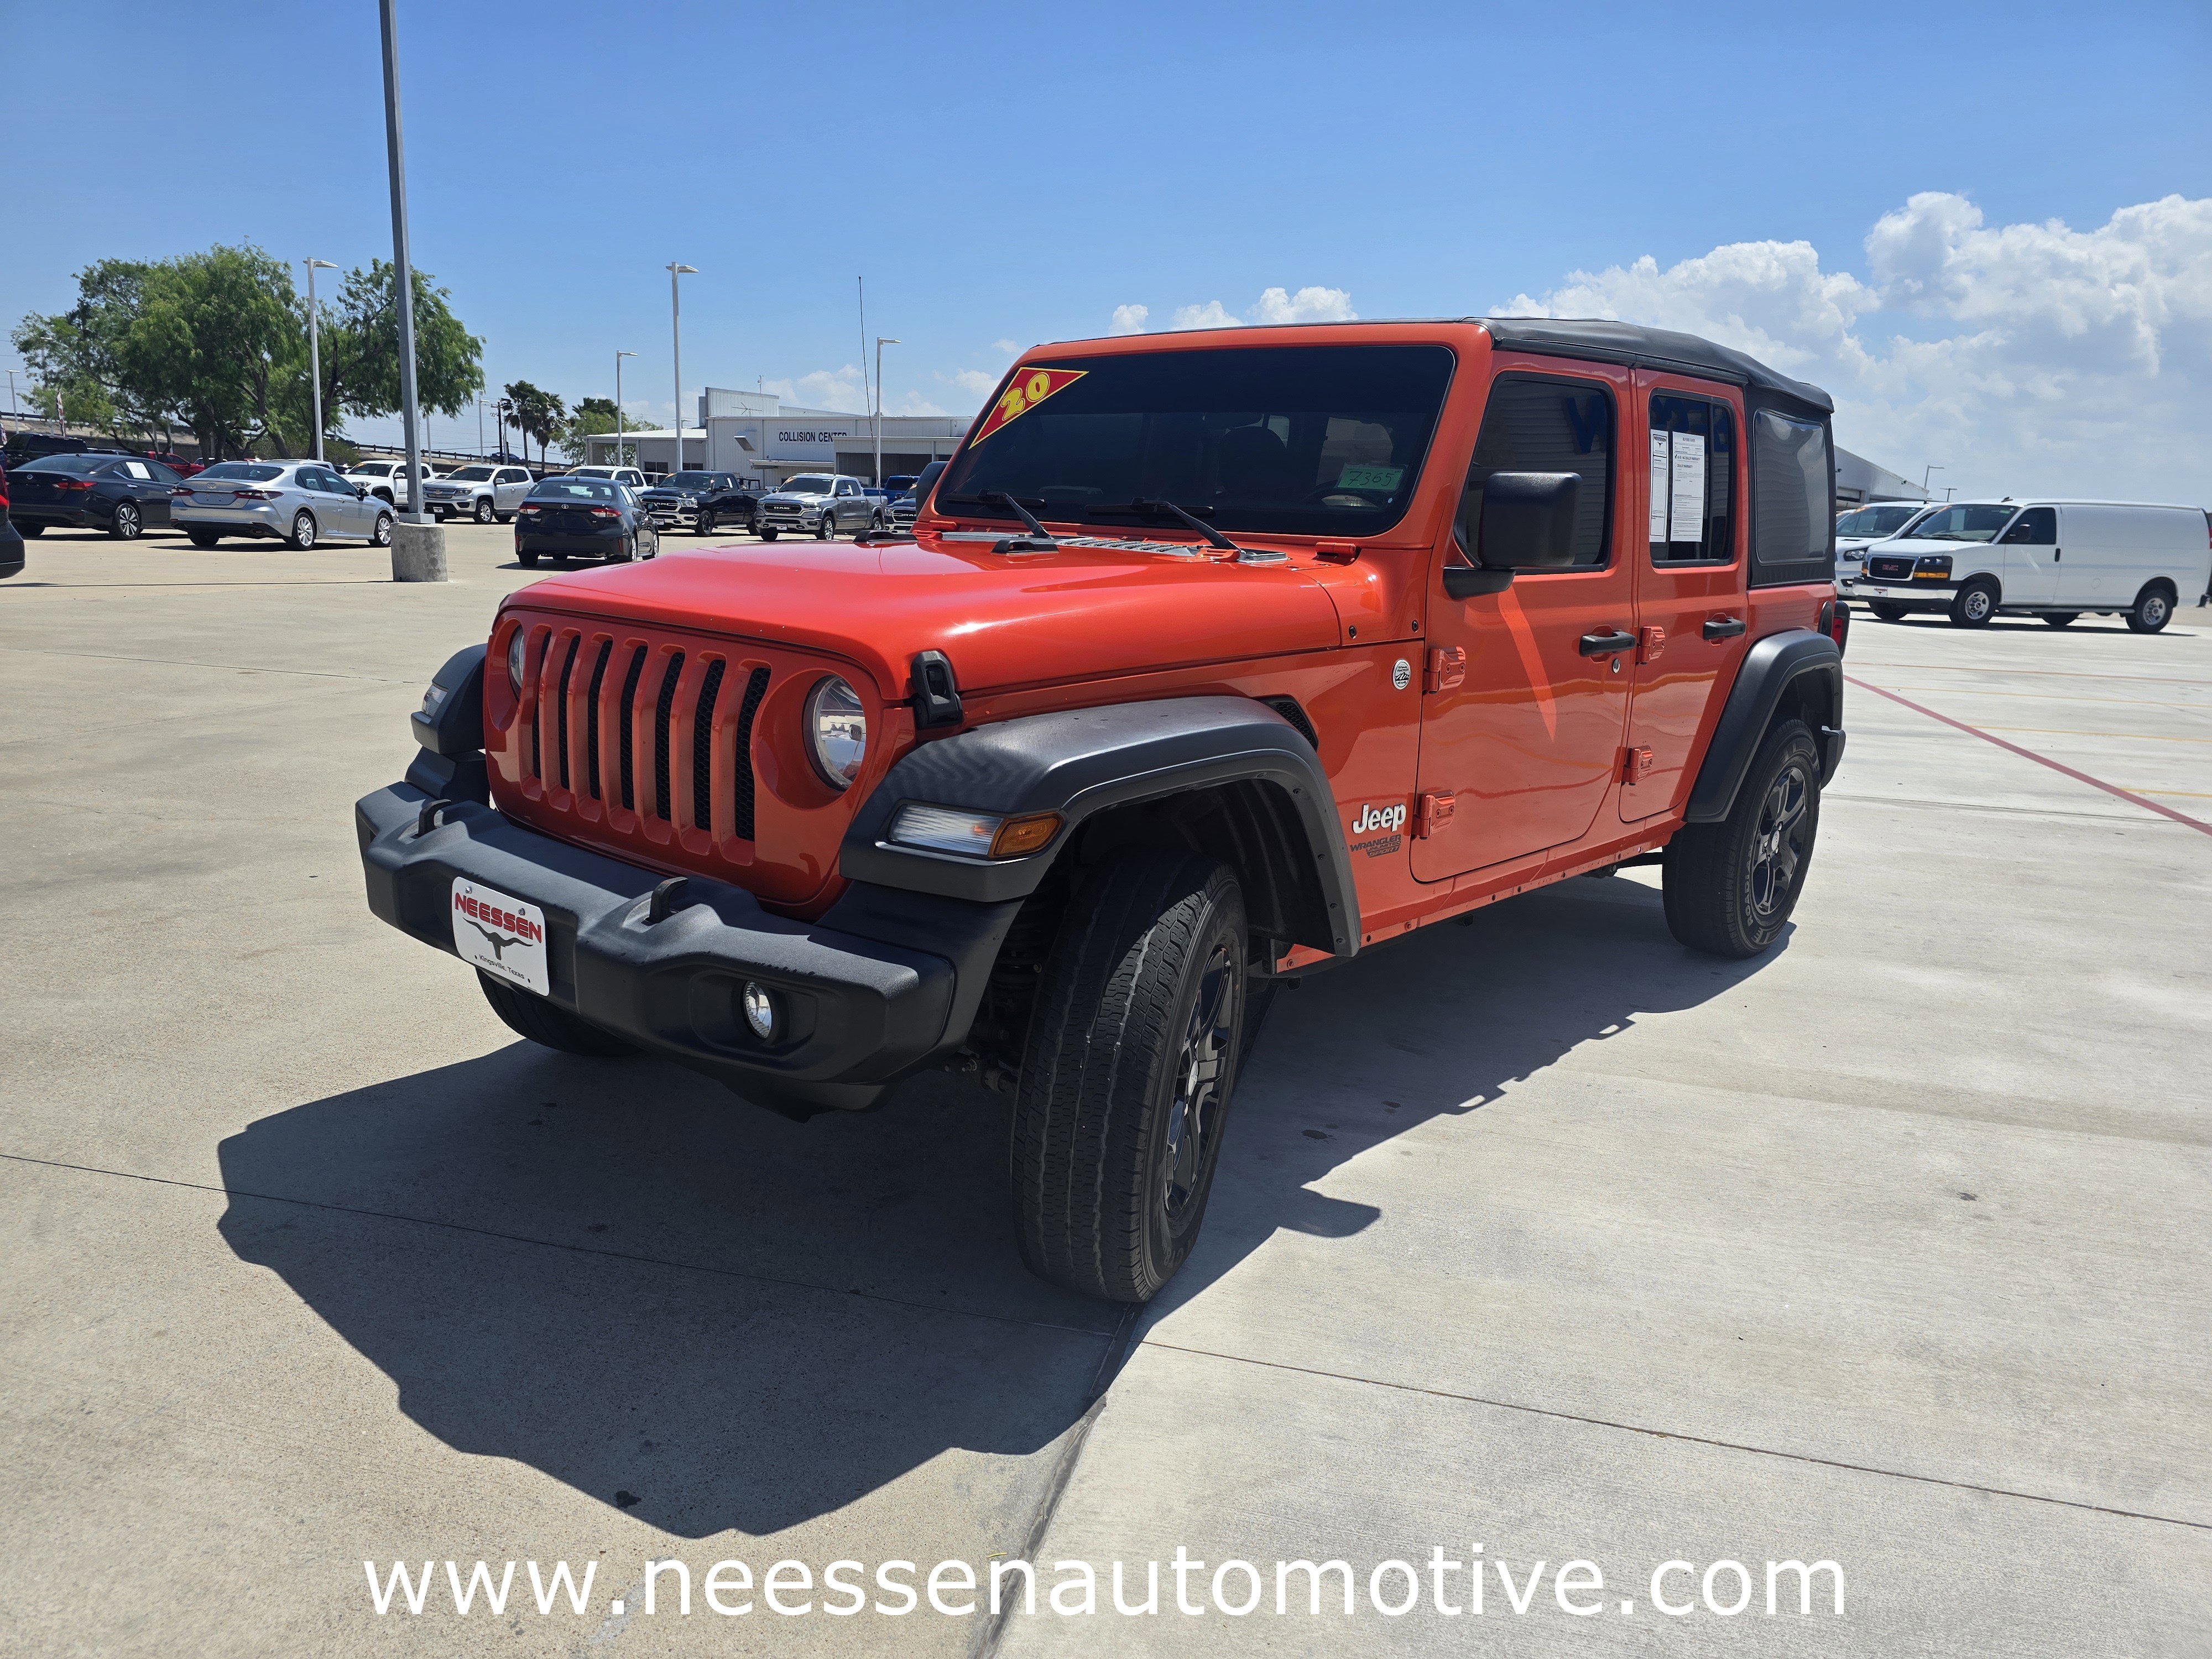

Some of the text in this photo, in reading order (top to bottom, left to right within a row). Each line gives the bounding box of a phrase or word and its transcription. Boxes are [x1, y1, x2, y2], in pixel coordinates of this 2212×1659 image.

[1000, 372, 1050, 421] 20
[779, 431, 816, 442] COLLISION
[1348, 471, 1395, 487] 7365
[1352, 803, 1406, 834] Jeep
[1350, 834, 1402, 852] WRANGLER
[1366, 841, 1401, 852] UNLIMITED
[1368, 846, 1400, 856] SPORT
[455, 892, 542, 944] NEESSEN
[507, 967, 525, 979] Texas
